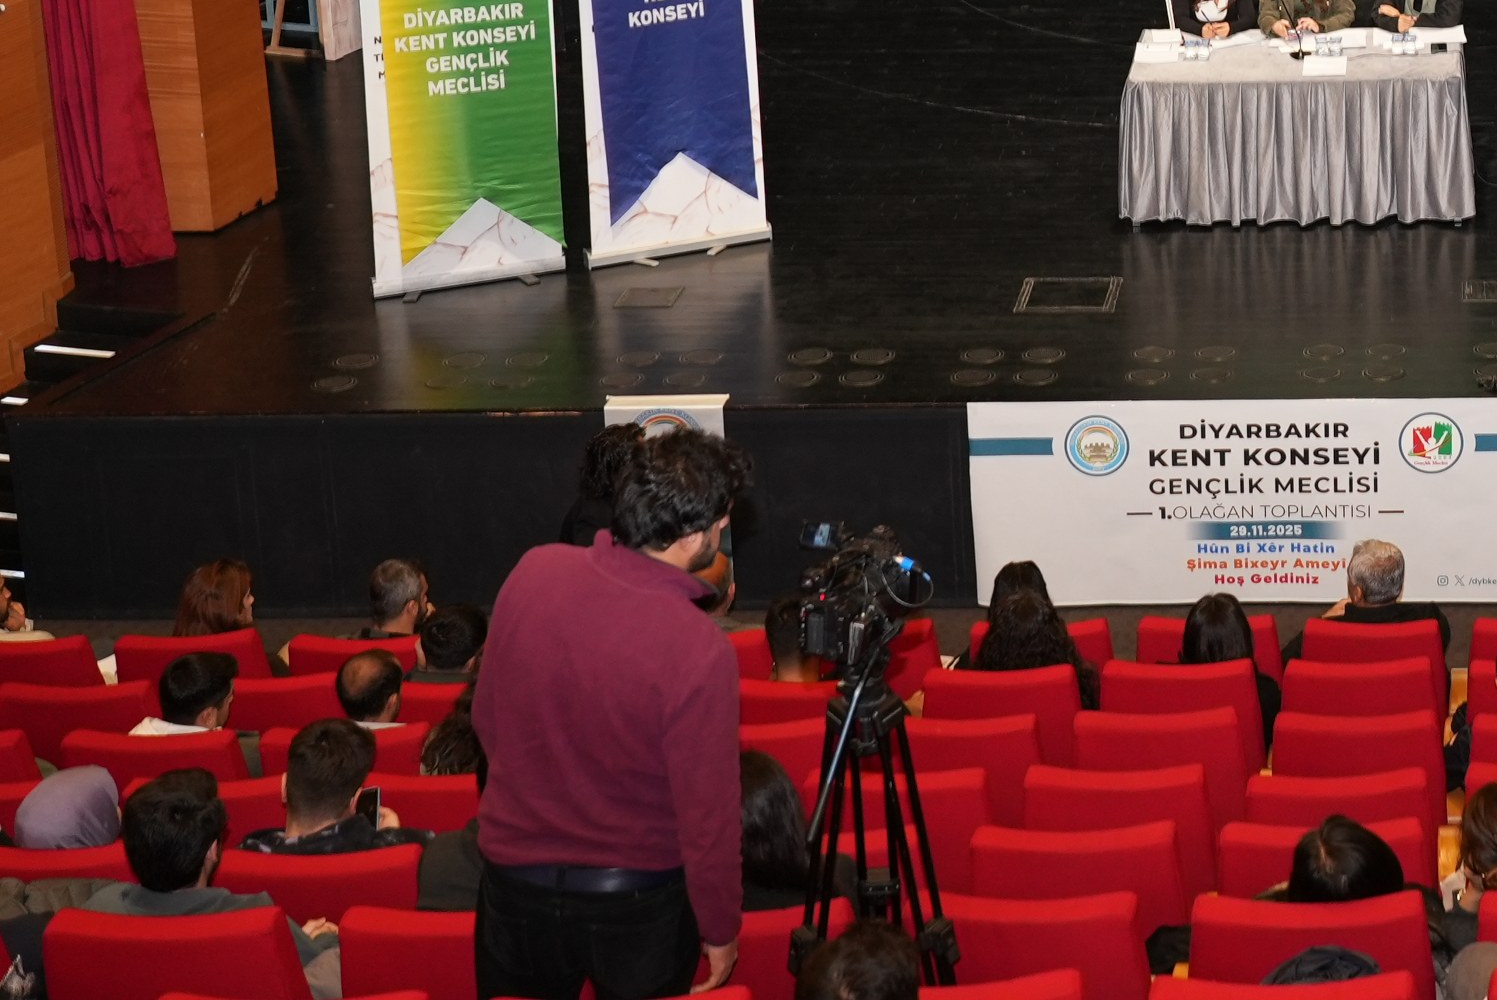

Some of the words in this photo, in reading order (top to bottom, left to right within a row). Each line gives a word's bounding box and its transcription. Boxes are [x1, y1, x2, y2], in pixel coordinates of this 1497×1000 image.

[403, 2, 524, 29] DİYARBAKIR
[394, 31, 446, 53] KENT
[452, 20, 536, 50] KONSEYİ
[425, 48, 510, 74] GENÇLİK
[427, 69, 507, 97] MECLİSİ
[1179, 419, 1349, 439] DİYARBAKIR
[1149, 448, 1231, 467] KENT
[1243, 441, 1380, 466] KONSEYİ
[1149, 473, 1265, 500] GENÇLİK
[1275, 472, 1378, 494] MECLİSİ
[1159, 502, 1254, 520] 1.OLAĞAN
[1260, 504, 1371, 519] TOPLANTISI
[1230, 524, 1302, 537] 29.11.2025
[1197, 542, 1230, 554] Hûn
[1235, 542, 1251, 554] Bi
[1257, 542, 1285, 554] Xêr
[1290, 541, 1335, 554] Hatin
[1186, 558, 1228, 572] Şima
[1233, 557, 1287, 572] Bixeyr
[1214, 573, 1245, 588] Hoş
[1250, 572, 1320, 585] Geldiniz
